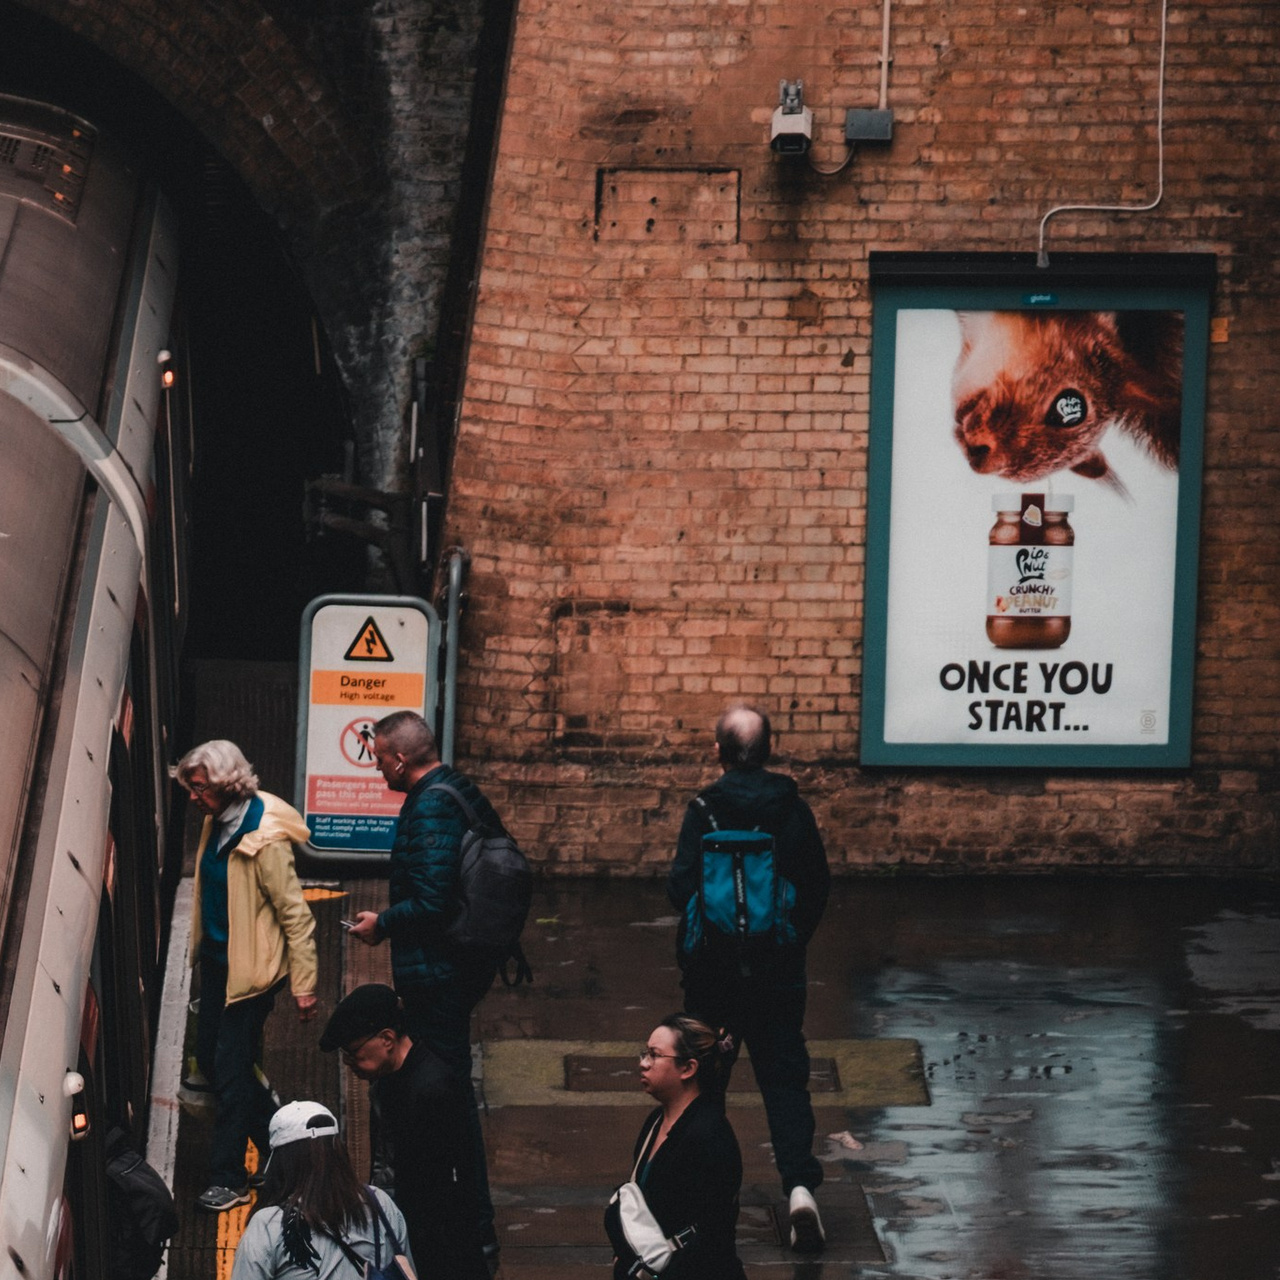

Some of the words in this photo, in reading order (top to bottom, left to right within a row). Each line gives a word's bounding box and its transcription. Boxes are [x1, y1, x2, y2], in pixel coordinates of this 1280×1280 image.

[1023, 561, 1046, 575] Nut
[1009, 584, 1056, 596] CRUNCHY
[1006, 594, 1059, 610] PEANUT
[340, 675, 387, 690] Danger
[939, 660, 1028, 694] ONCE
[1038, 660, 1113, 695] YOU
[340, 691, 360, 701] High
[363, 692, 395, 702] voltage
[968, 699, 1089, 732] START...
[316, 779, 367, 791] Passengers
[315, 791, 336, 800] pass
[339, 790, 356, 798] this
[358, 791, 382, 800] point
[332, 818, 356, 826] working
